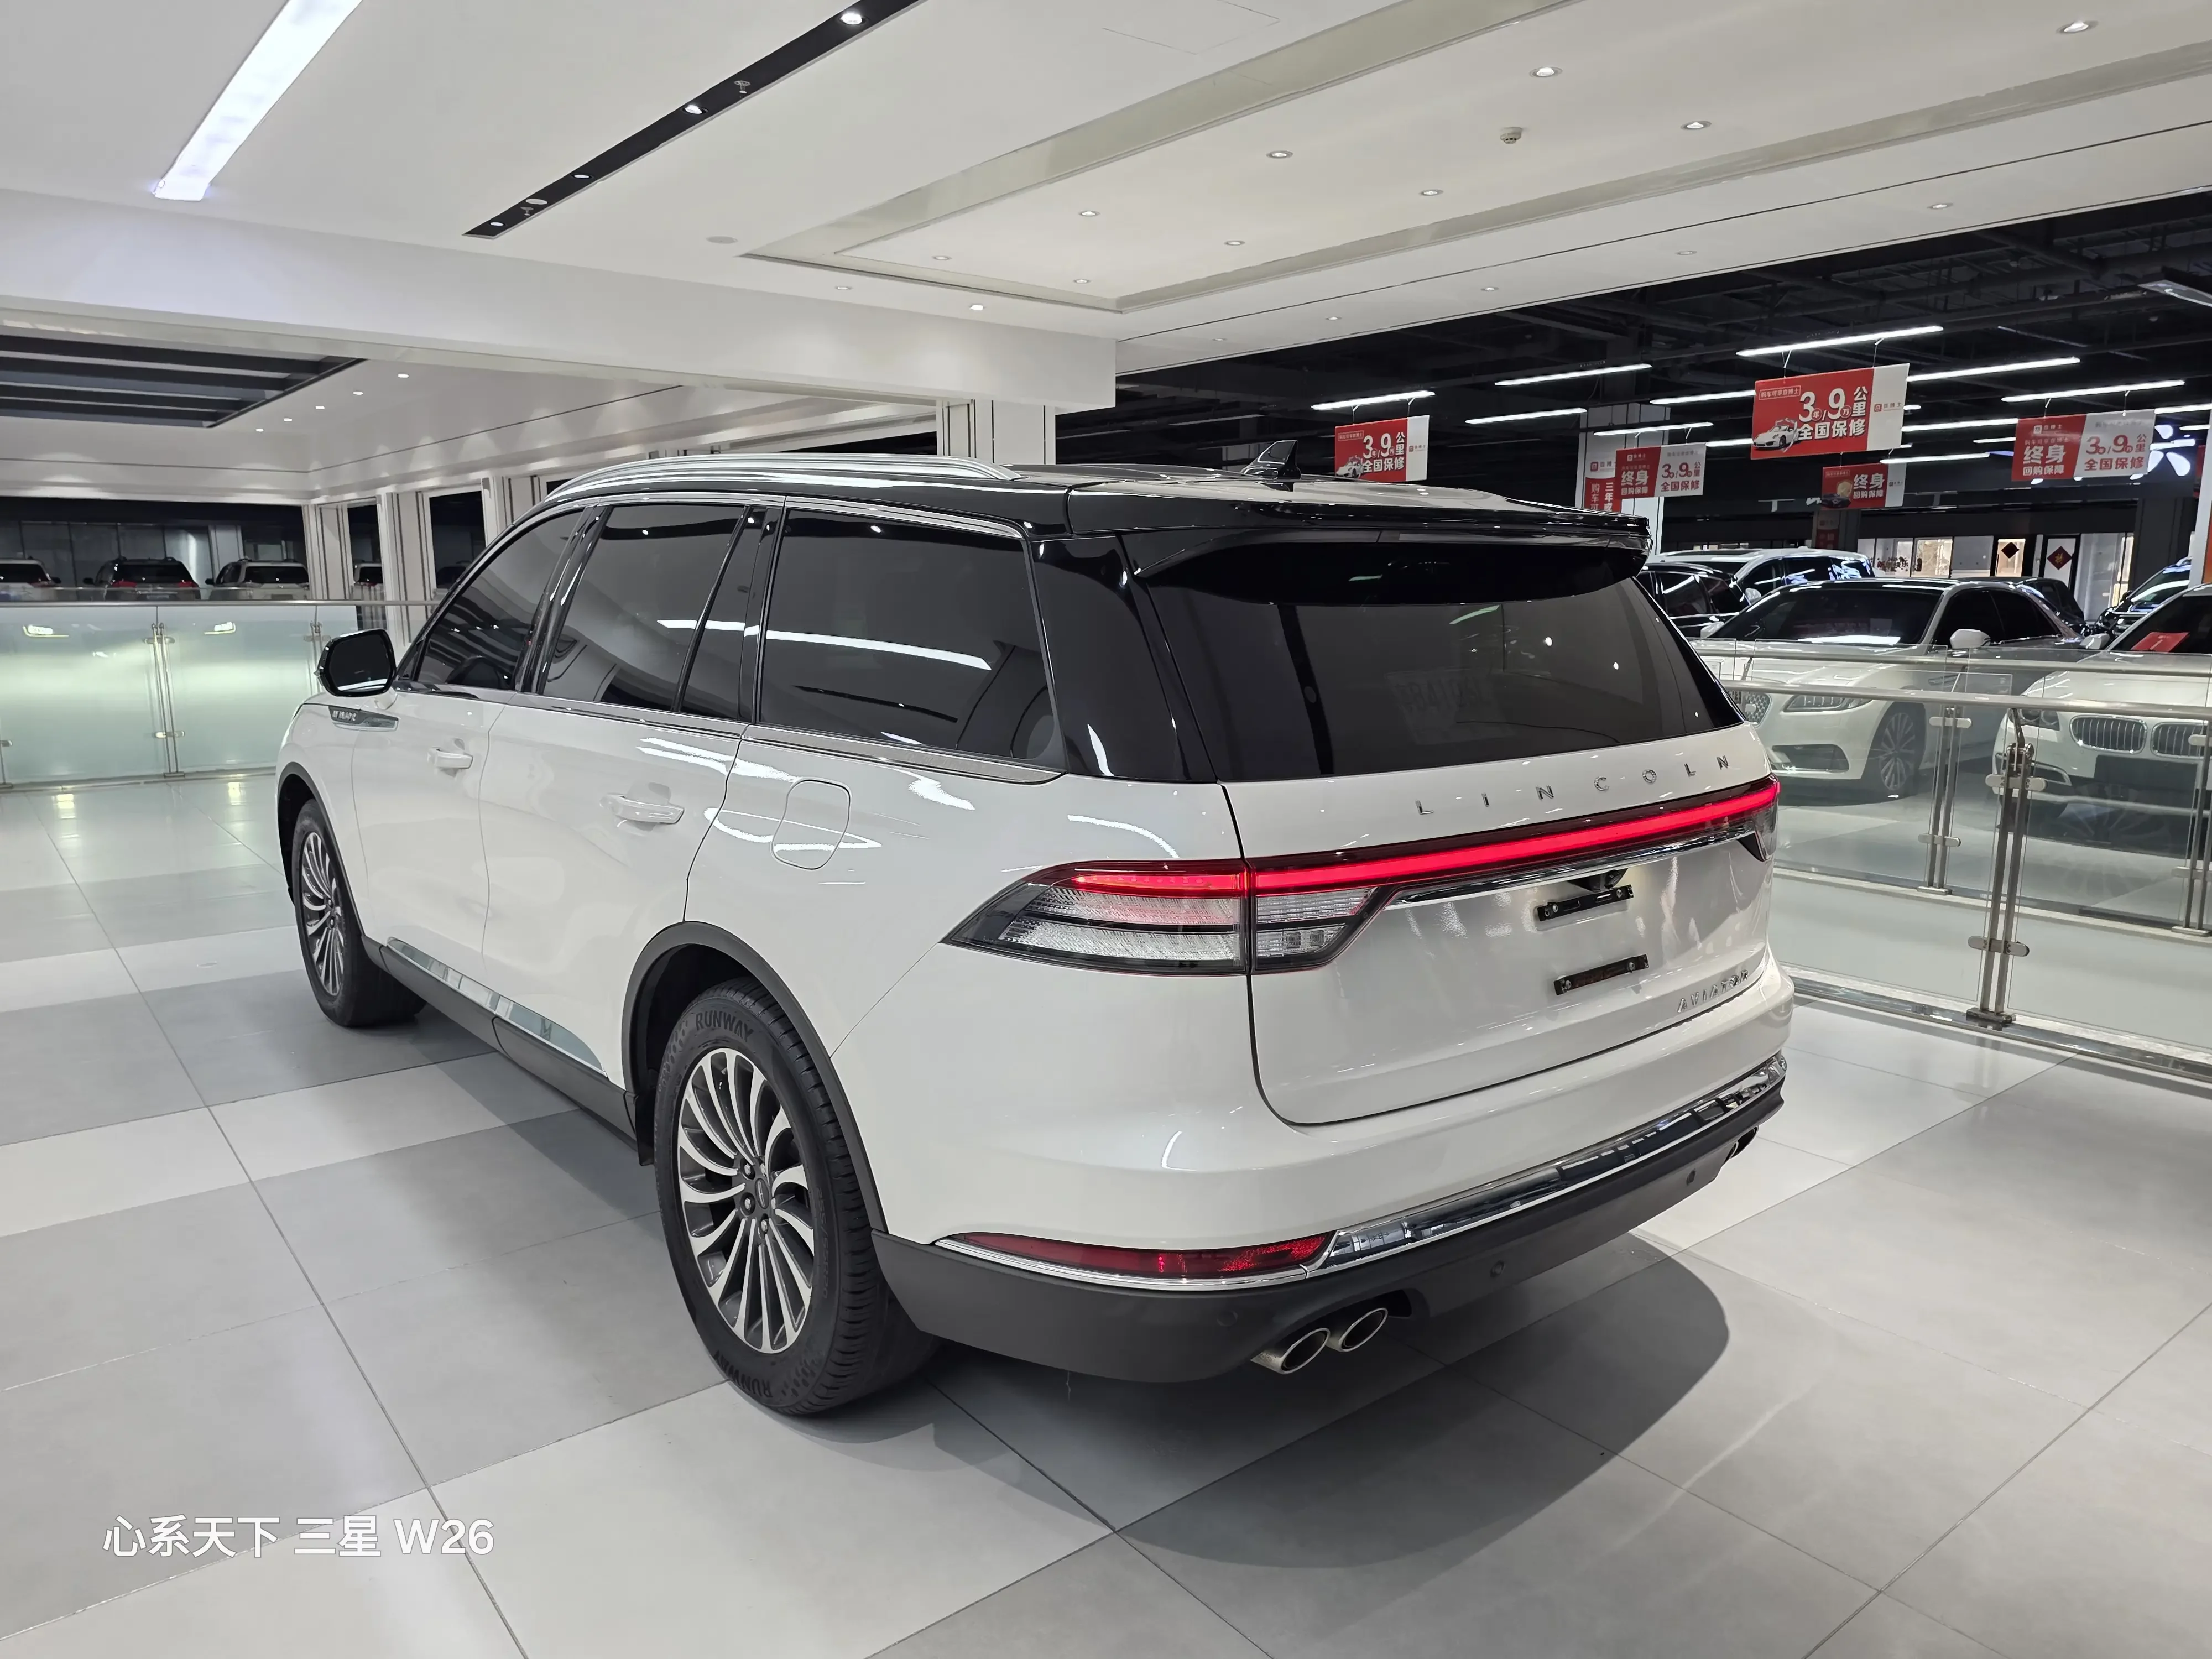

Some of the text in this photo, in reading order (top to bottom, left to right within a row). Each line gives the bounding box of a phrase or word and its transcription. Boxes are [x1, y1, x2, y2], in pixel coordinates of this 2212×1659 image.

[1851, 386, 1868, 416] 公里
[1797, 419, 1865, 441] 全国保修
[1363, 457, 1405, 473] 全国保修
[2023, 444, 2066, 465] 终身
[2084, 456, 2145, 471] 全国保修
[1621, 470, 1649, 486] 终身
[1661, 479, 1700, 492] 全国保修
[1853, 473, 1885, 489] 终身
[1415, 755, 1730, 816] LINCOLN
[1677, 969, 1748, 1013] AVIATOR
[696, 1010, 754, 1042] RUNWAY
[712, 1349, 774, 1398] RUNWAY
